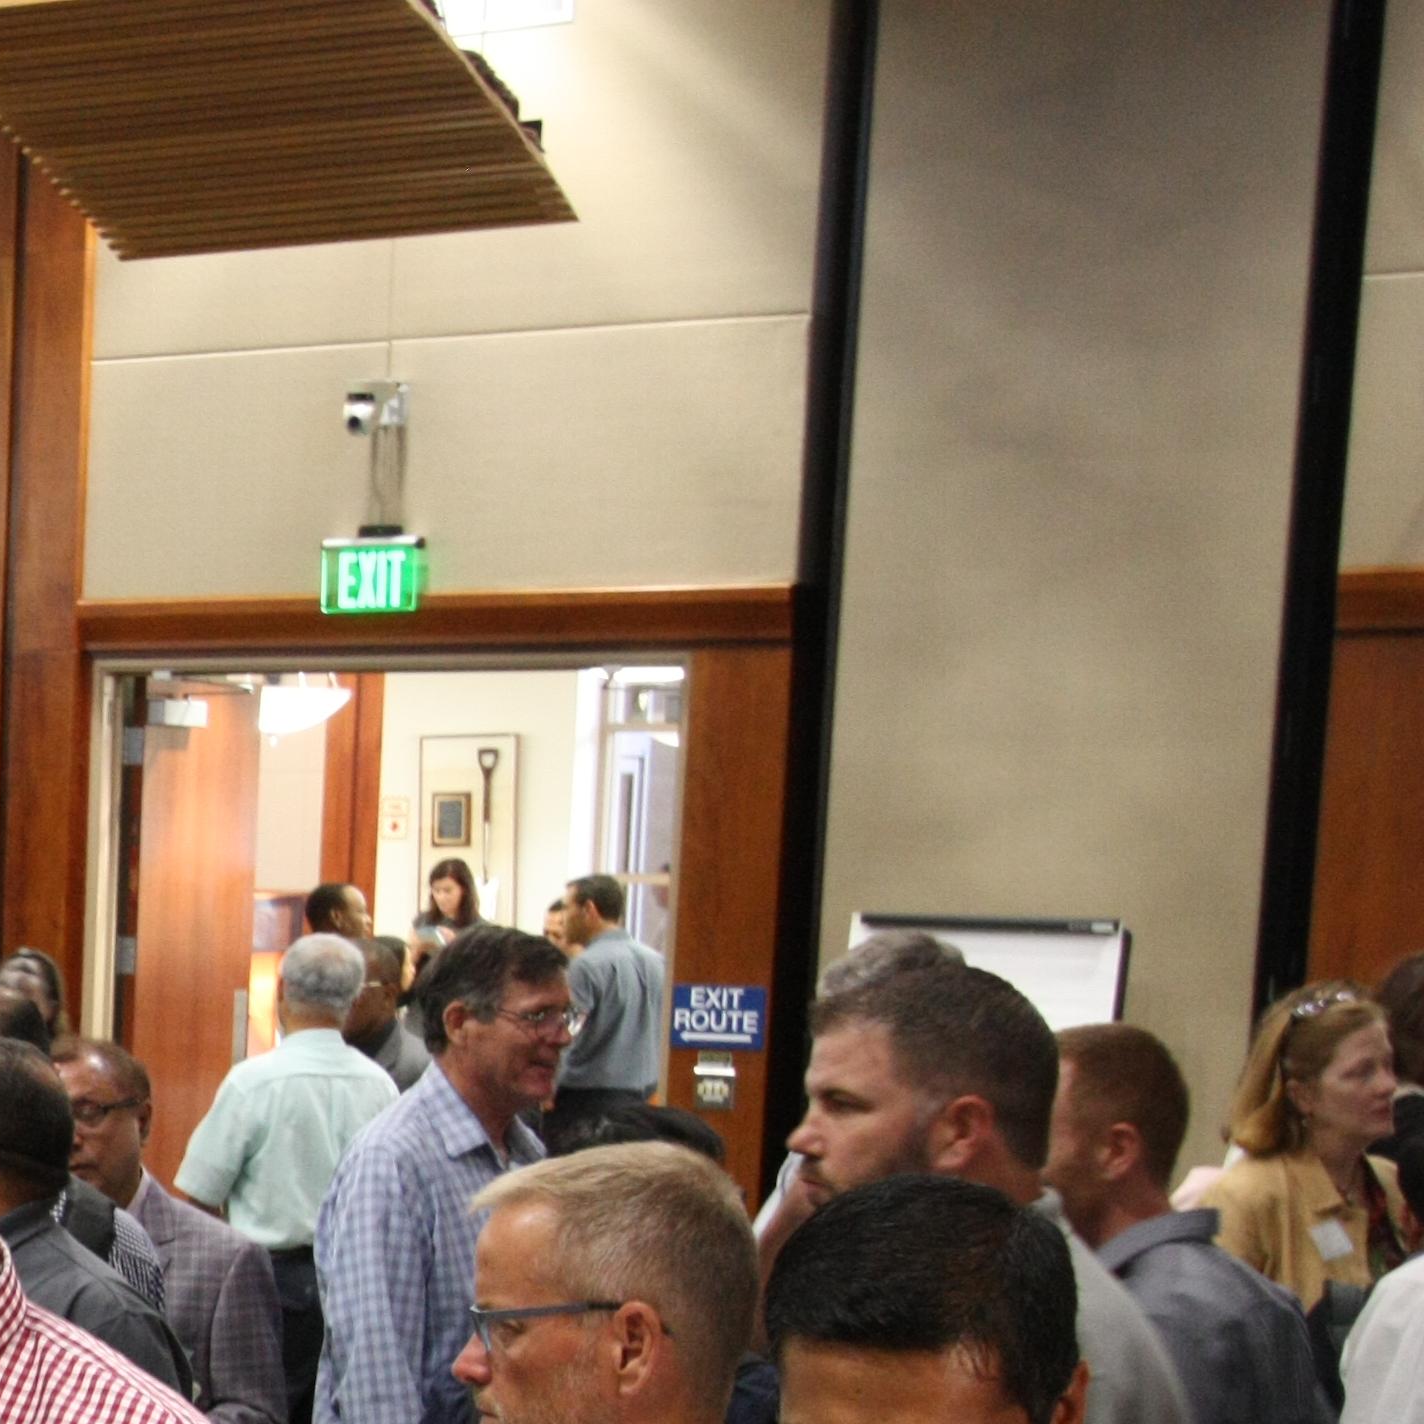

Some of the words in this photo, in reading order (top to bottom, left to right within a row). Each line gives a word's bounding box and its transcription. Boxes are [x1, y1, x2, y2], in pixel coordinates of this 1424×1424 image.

[337, 550, 407, 609] EXIT
[690, 986, 745, 1010] EXIT
[673, 1007, 759, 1034] ROUTE
